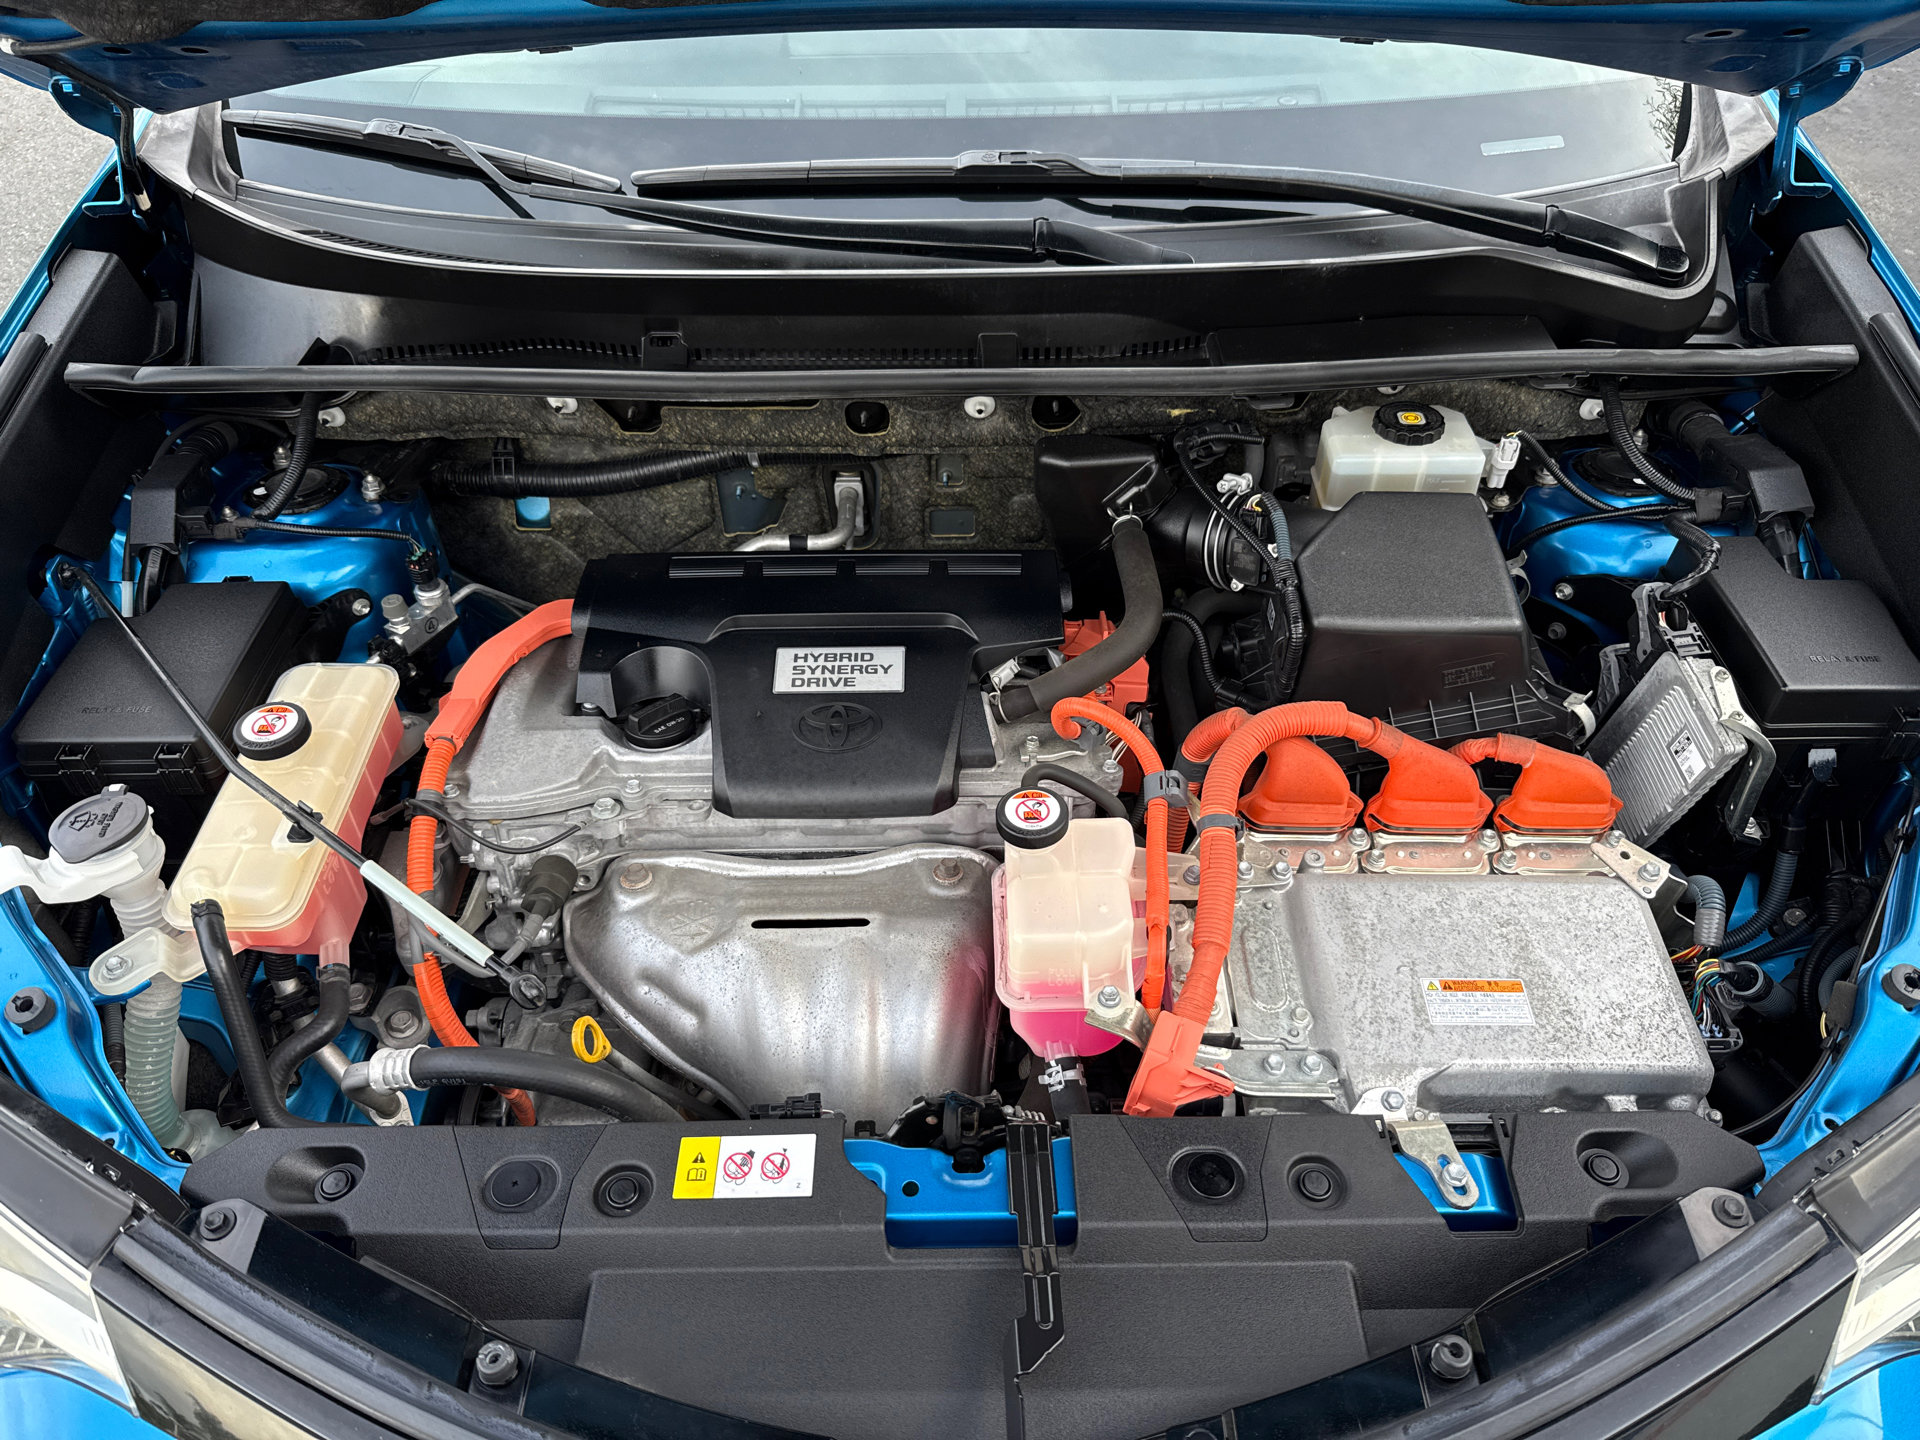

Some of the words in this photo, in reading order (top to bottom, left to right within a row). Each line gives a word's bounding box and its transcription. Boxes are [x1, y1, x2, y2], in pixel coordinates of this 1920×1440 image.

[793, 652, 874, 663] HYBRID
[791, 664, 893, 675] SYNERGY
[790, 677, 856, 688] DRIVE
[126, 705, 153, 714] FUSE
[1047, 978, 1076, 987] LOW
